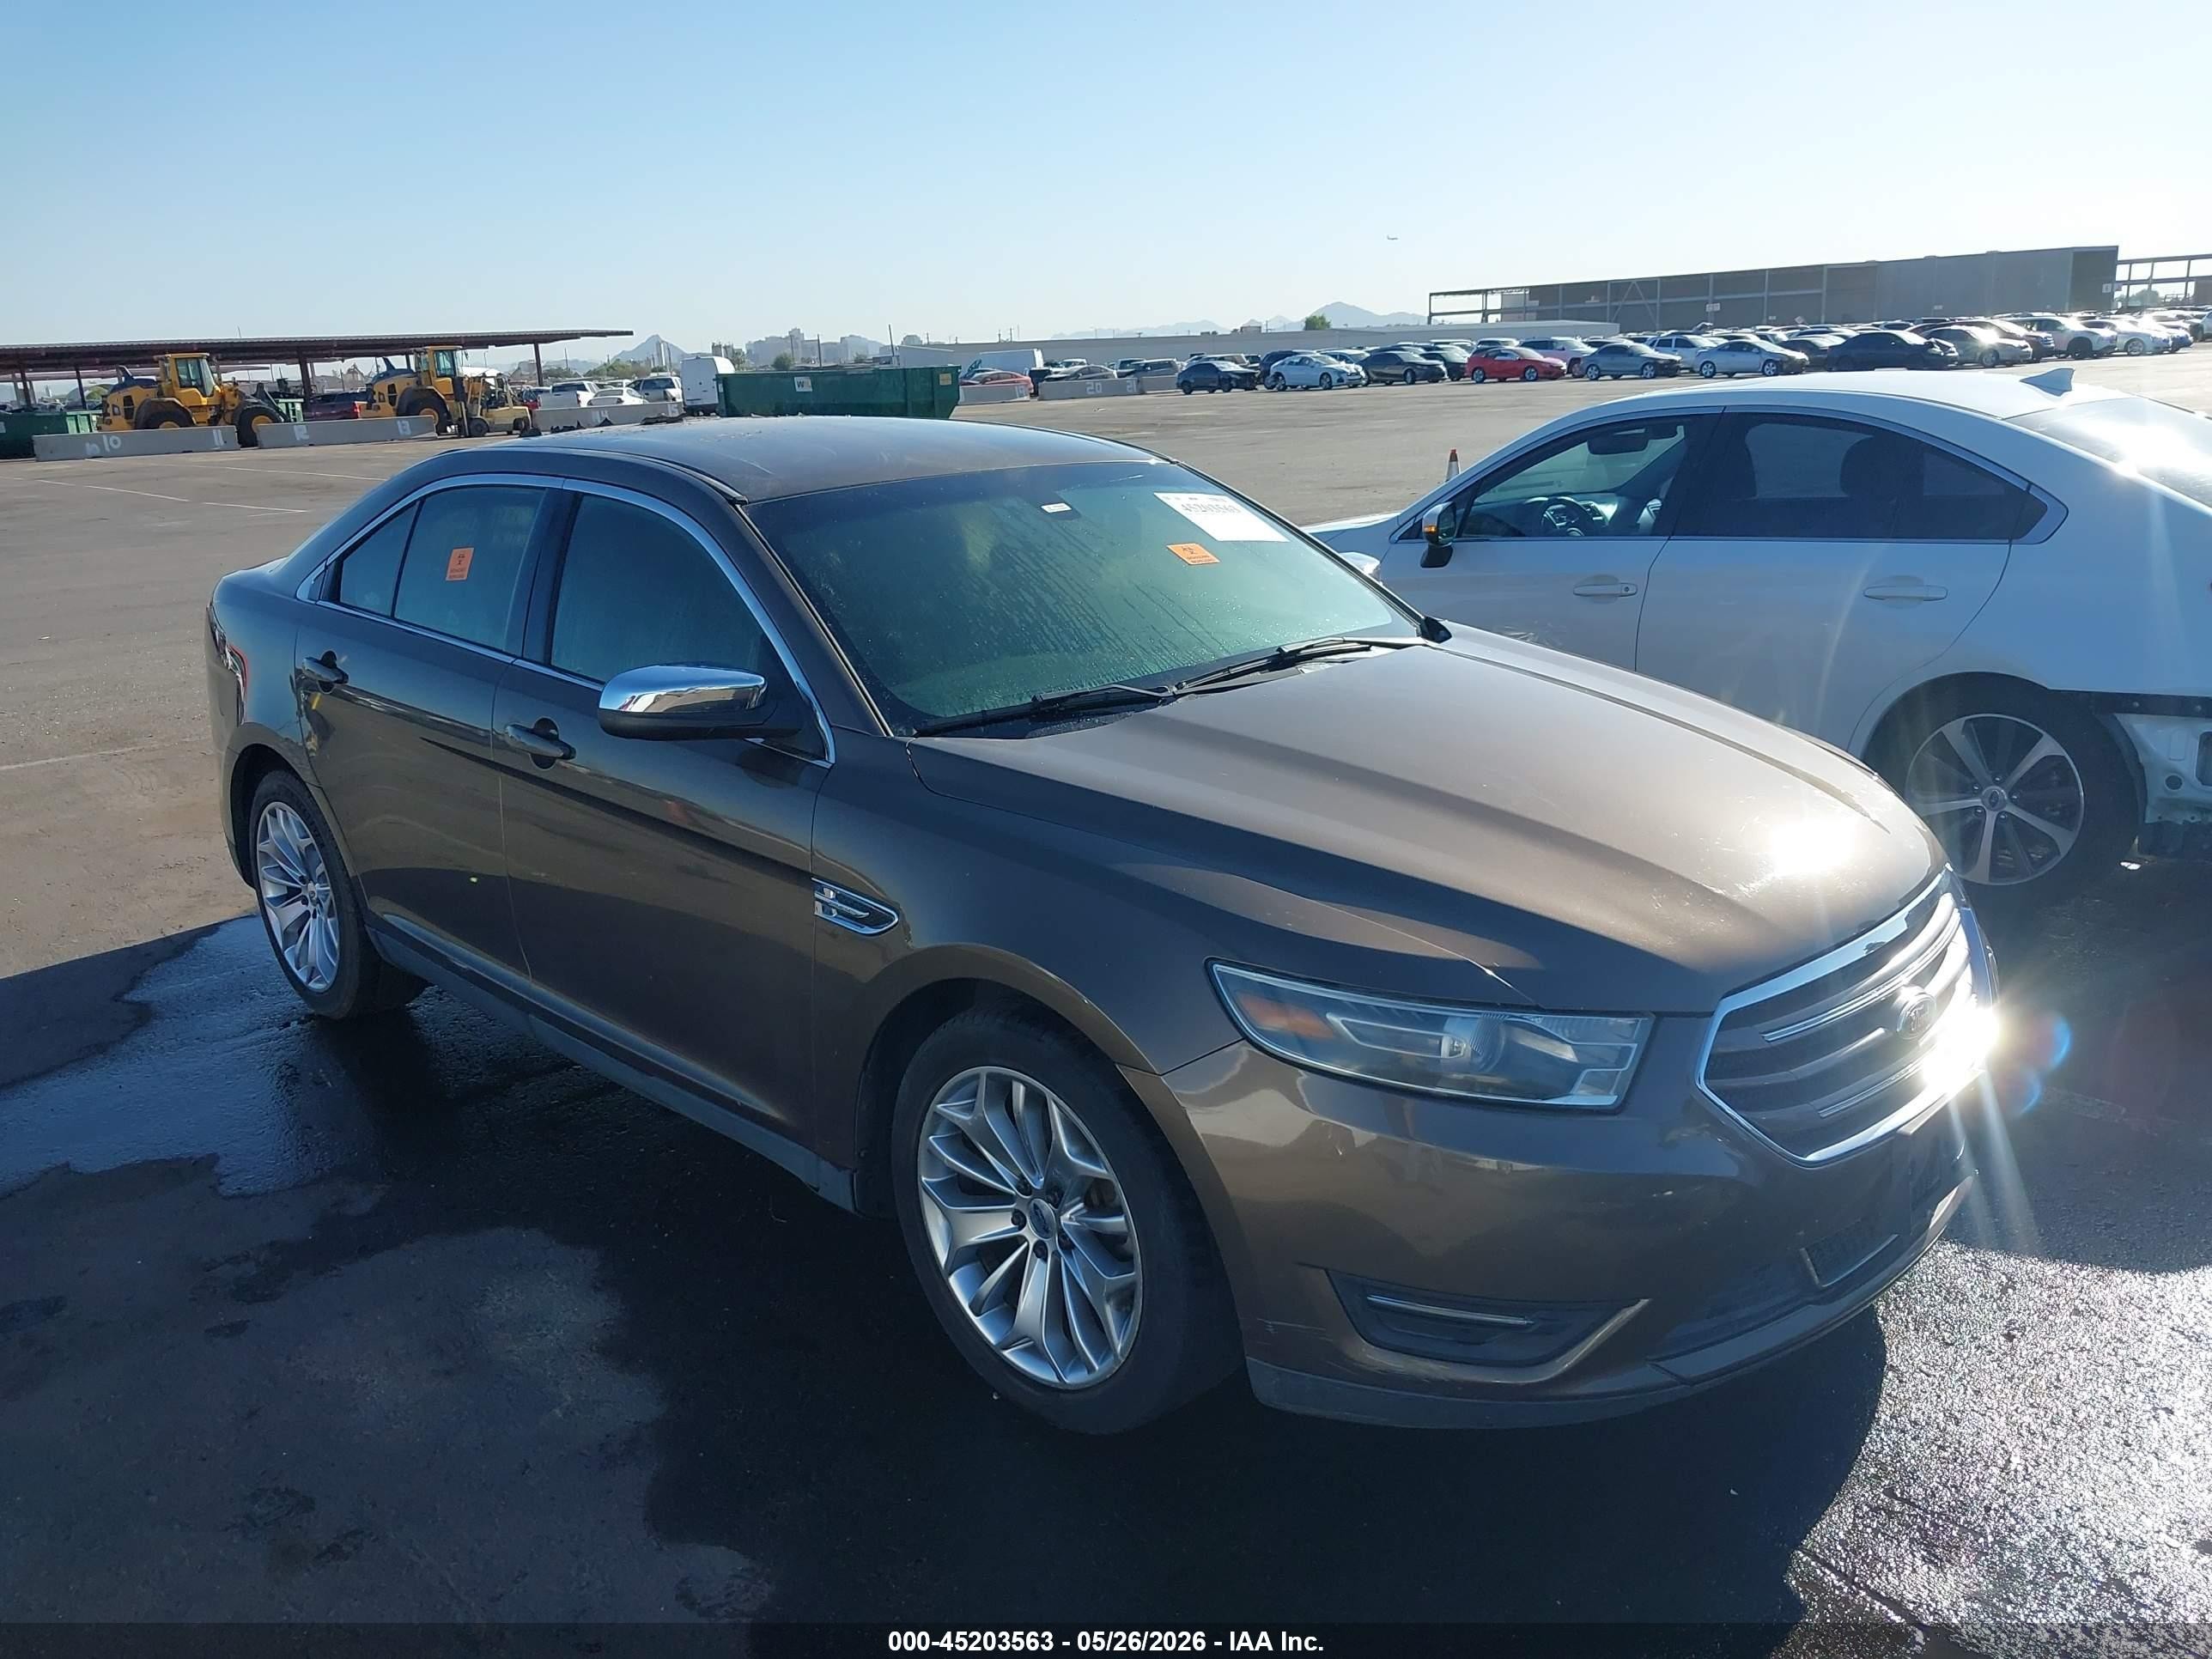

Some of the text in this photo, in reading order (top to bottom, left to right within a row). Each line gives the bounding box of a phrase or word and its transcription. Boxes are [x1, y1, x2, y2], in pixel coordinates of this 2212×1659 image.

[1086, 382, 1103, 394] 20
[667, 404, 678, 417] 15
[102, 434, 122, 453] 10
